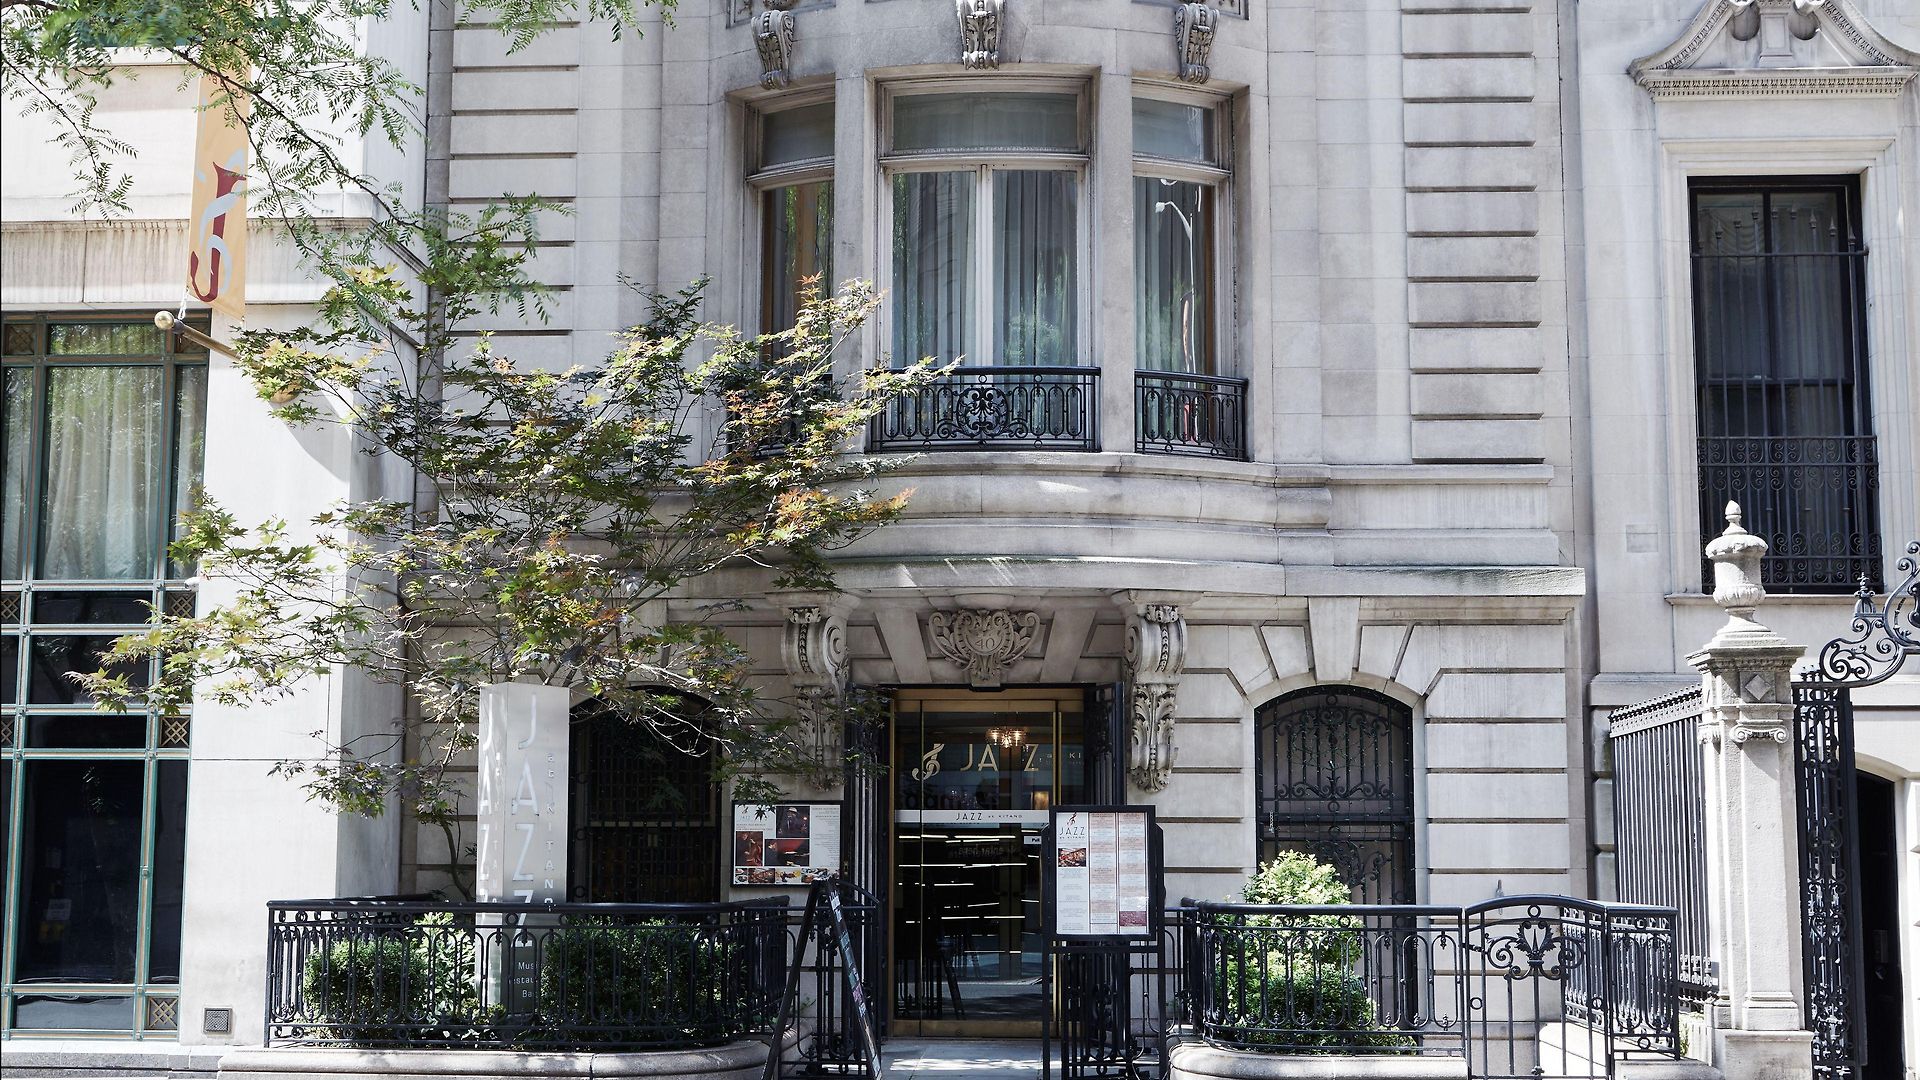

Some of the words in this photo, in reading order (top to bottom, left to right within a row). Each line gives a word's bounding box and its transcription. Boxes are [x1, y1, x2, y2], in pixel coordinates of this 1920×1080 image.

[960, 743, 1039, 771] JAZ
[512, 694, 539, 947] JAZZ
[956, 812, 982, 821] JAZZ
[1059, 826, 1085, 836] JAZZ
